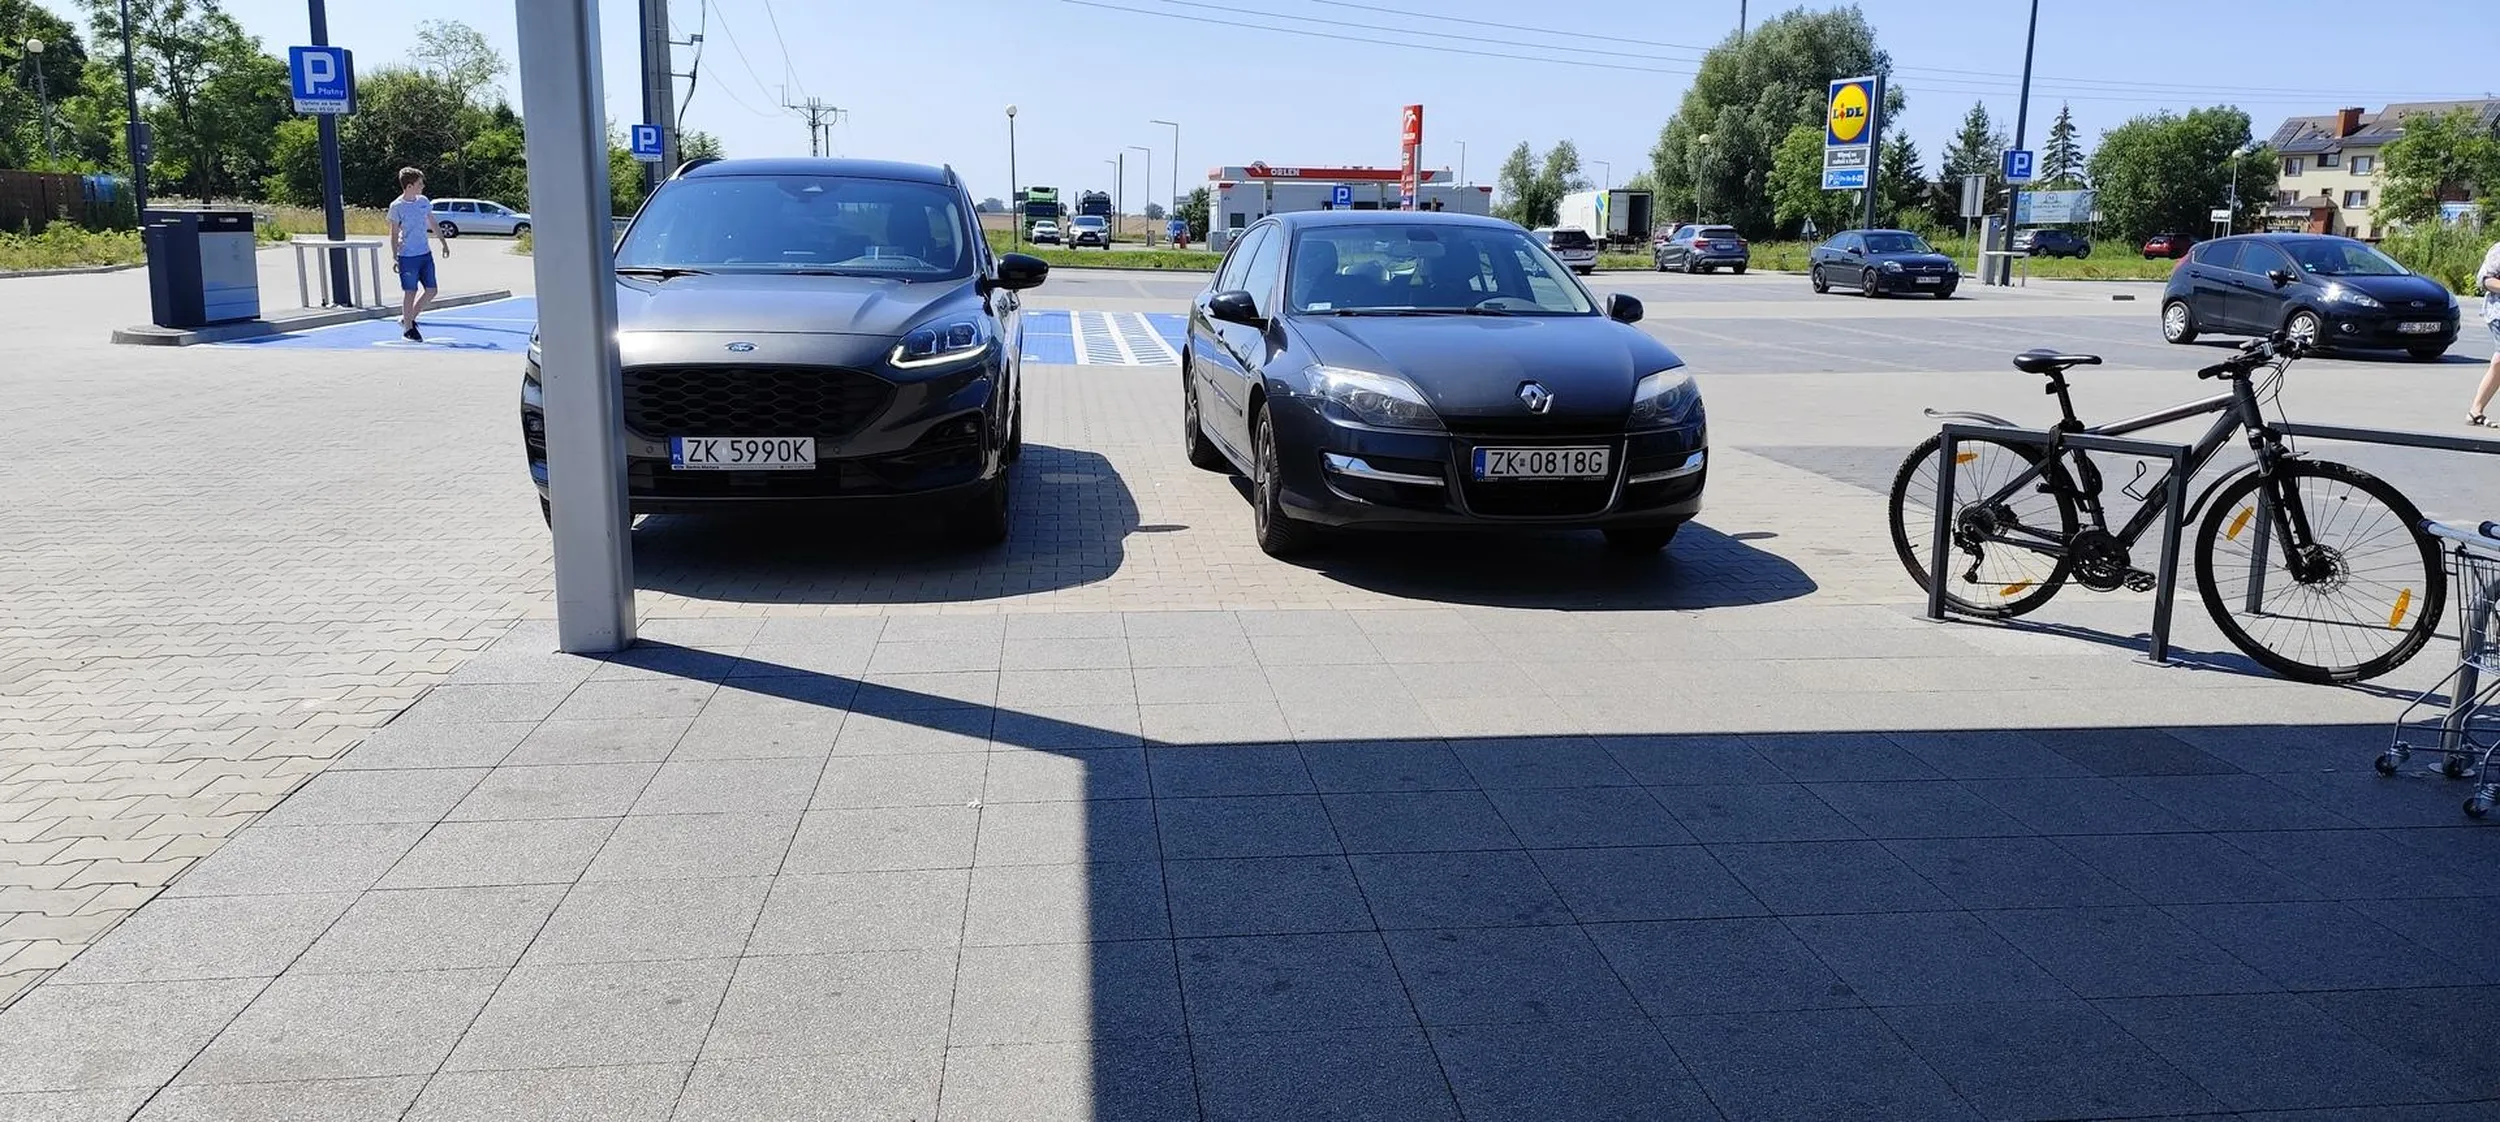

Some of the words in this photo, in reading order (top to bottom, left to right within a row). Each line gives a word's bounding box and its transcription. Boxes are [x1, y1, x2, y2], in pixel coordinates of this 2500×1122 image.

[302, 52, 335, 94] P
[639, 127, 656, 152] P
[1271, 168, 1300, 176] ORLEN
[2014, 153, 2029, 175] P
[1337, 188, 1348, 203] P
[687, 440, 720, 462] ZK
[730, 440, 808, 463] 5990K
[1490, 452, 1521, 474] ZK
[1530, 451, 1603, 473] 0818G
